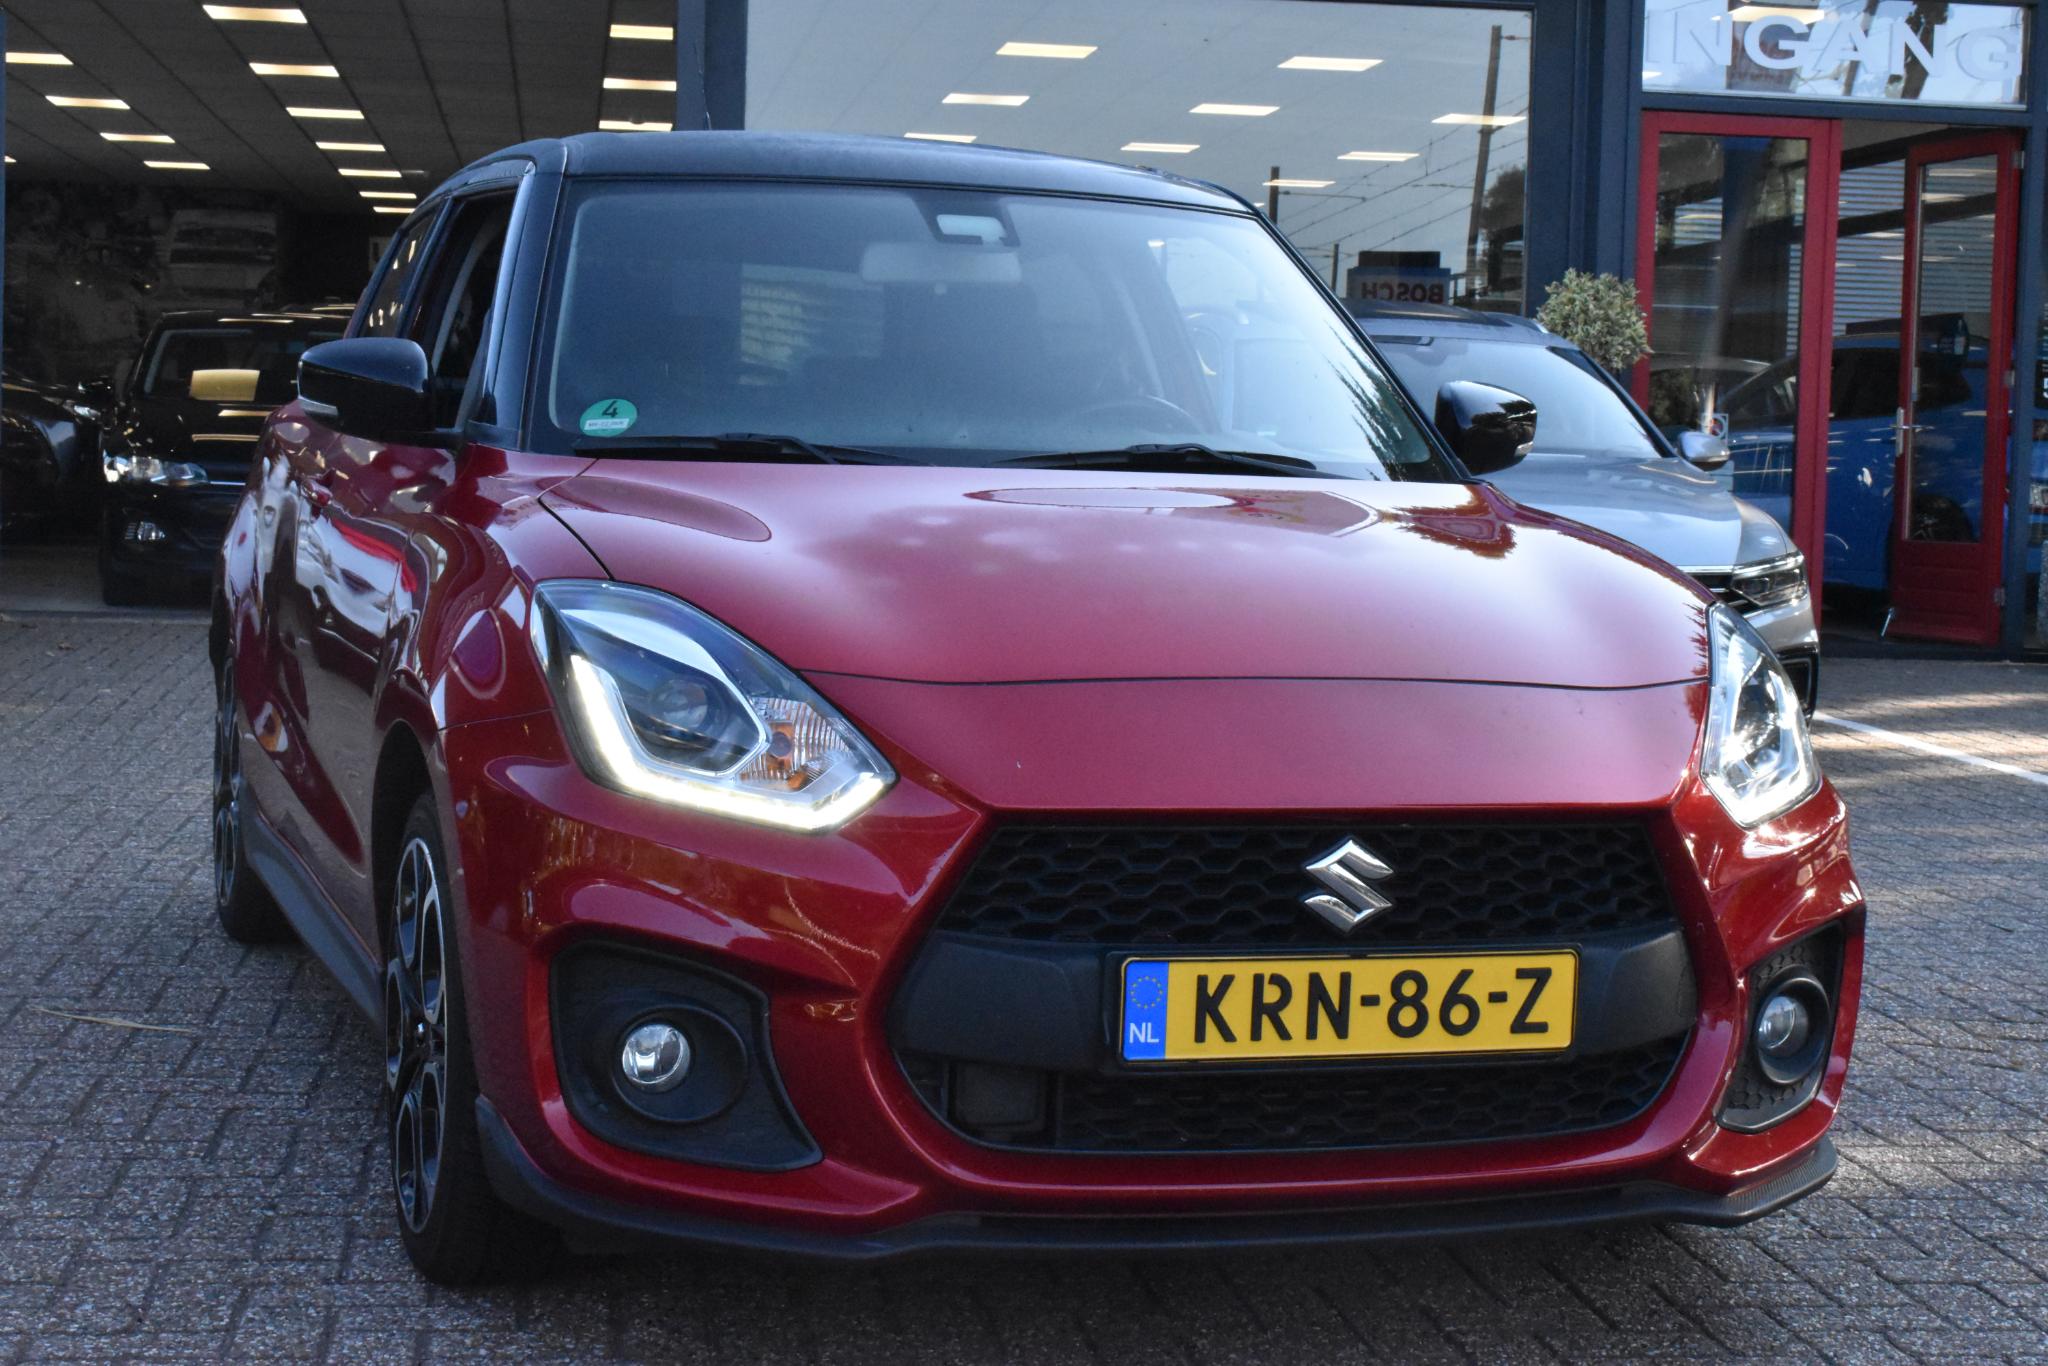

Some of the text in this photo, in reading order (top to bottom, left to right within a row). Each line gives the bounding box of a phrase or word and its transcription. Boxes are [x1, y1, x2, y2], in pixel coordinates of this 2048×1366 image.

[1646, 11, 2022, 81] INGANG
[602, 400, 618, 418] 4
[1194, 968, 1553, 1043] KRN-86-Z
[1129, 1022, 1159, 1043] NL
